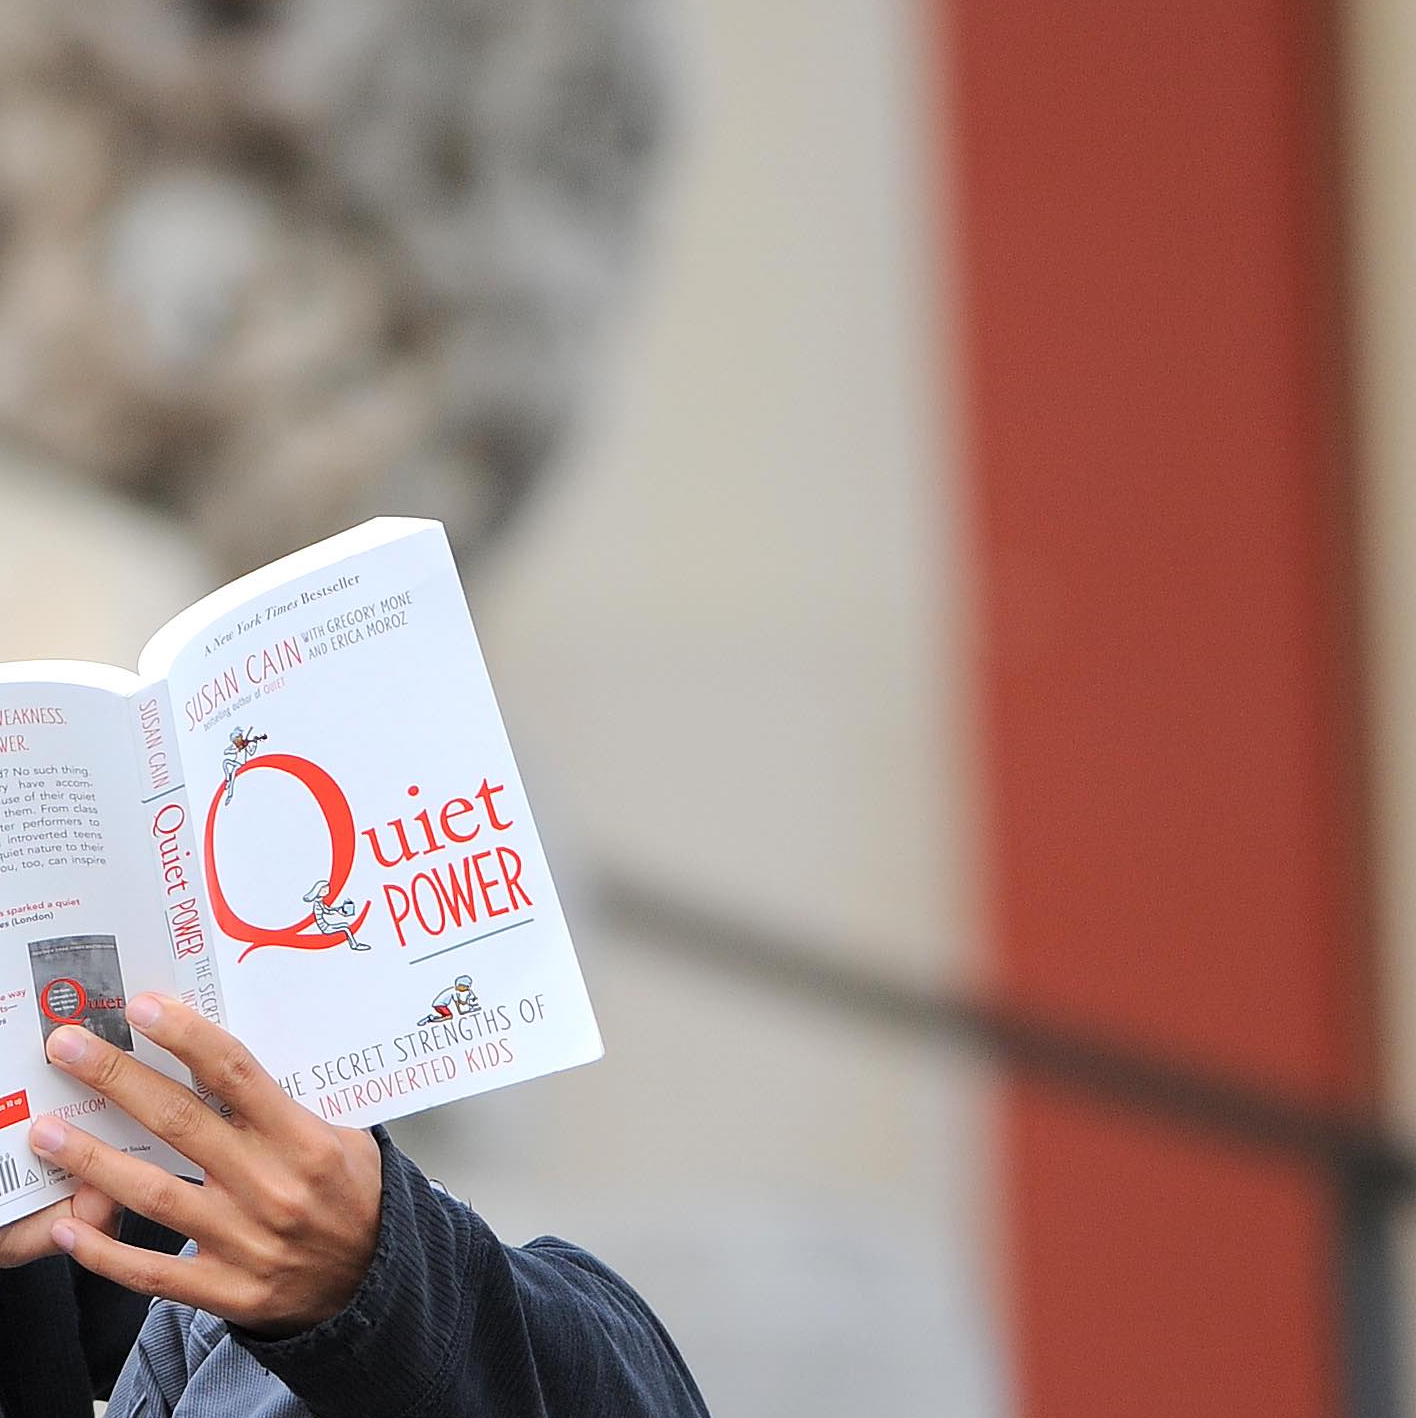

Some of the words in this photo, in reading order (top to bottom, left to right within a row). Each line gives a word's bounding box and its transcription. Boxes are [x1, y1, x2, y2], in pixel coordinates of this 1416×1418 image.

[204, 645, 212, 657] A
[213, 630, 234, 651] New
[236, 613, 262, 635] York
[264, 599, 298, 621] Times
[301, 574, 361, 605] Bestseller
[300, 628, 325, 643] WITH
[326, 604, 376, 634] GREGORY
[380, 591, 413, 614] MONE
[309, 642, 328, 660] AND
[331, 629, 364, 652] ERICA
[366, 611, 408, 638] MOROZ
[185, 666, 239, 732] SUSAN
[246, 636, 302, 684] CAIN
[232, 693, 252, 711] author
[254, 687, 261, 699] of
[263, 676, 286, 694] QUIET
[140, 699, 160, 749] SUSAN
[13, 767, 30, 777] No
[34, 765, 58, 775] such
[61, 765, 91, 777] thing.
[19, 780, 45, 790] have
[55, 780, 93, 788] accom-
[148, 752, 169, 790] CAIN
[4, 807, 36, 819] them.
[41, 804, 69, 814] From
[73, 805, 99, 814] class
[24, 792, 35, 802] of
[40, 792, 64, 801] their
[69, 793, 96, 803] quiet
[7, 830, 68, 844] introverted
[73, 830, 103, 840] teens
[23, 818, 83, 830] performers
[89, 818, 100, 827] to
[22, 859, 44, 869] too,
[48, 857, 68, 866] can
[71, 854, 107, 866] inspire
[27, 843, 62, 855] nature
[65, 842, 77, 852] to
[80, 842, 104, 852] their
[153, 804, 191, 896] Quiet
[203, 753, 513, 964] Quiet
[6, 901, 45, 916] sparked
[55, 898, 81, 909] quiet
[383, 846, 533, 948] POWER
[11, 911, 54, 927] (London)
[169, 898, 204, 960] POWER
[195, 957, 214, 984] THE
[8, 989, 27, 1001] way
[40, 977, 124, 1025] Quiet
[278, 1071, 306, 1099] HE
[312, 1043, 385, 1090] SECRET
[393, 1005, 512, 1063] STRENGTHS
[519, 993, 545, 1023] OF
[318, 1054, 457, 1119] INTROVERTED
[465, 1037, 513, 1073] KIDS
[14, 1098, 23, 1106] up
